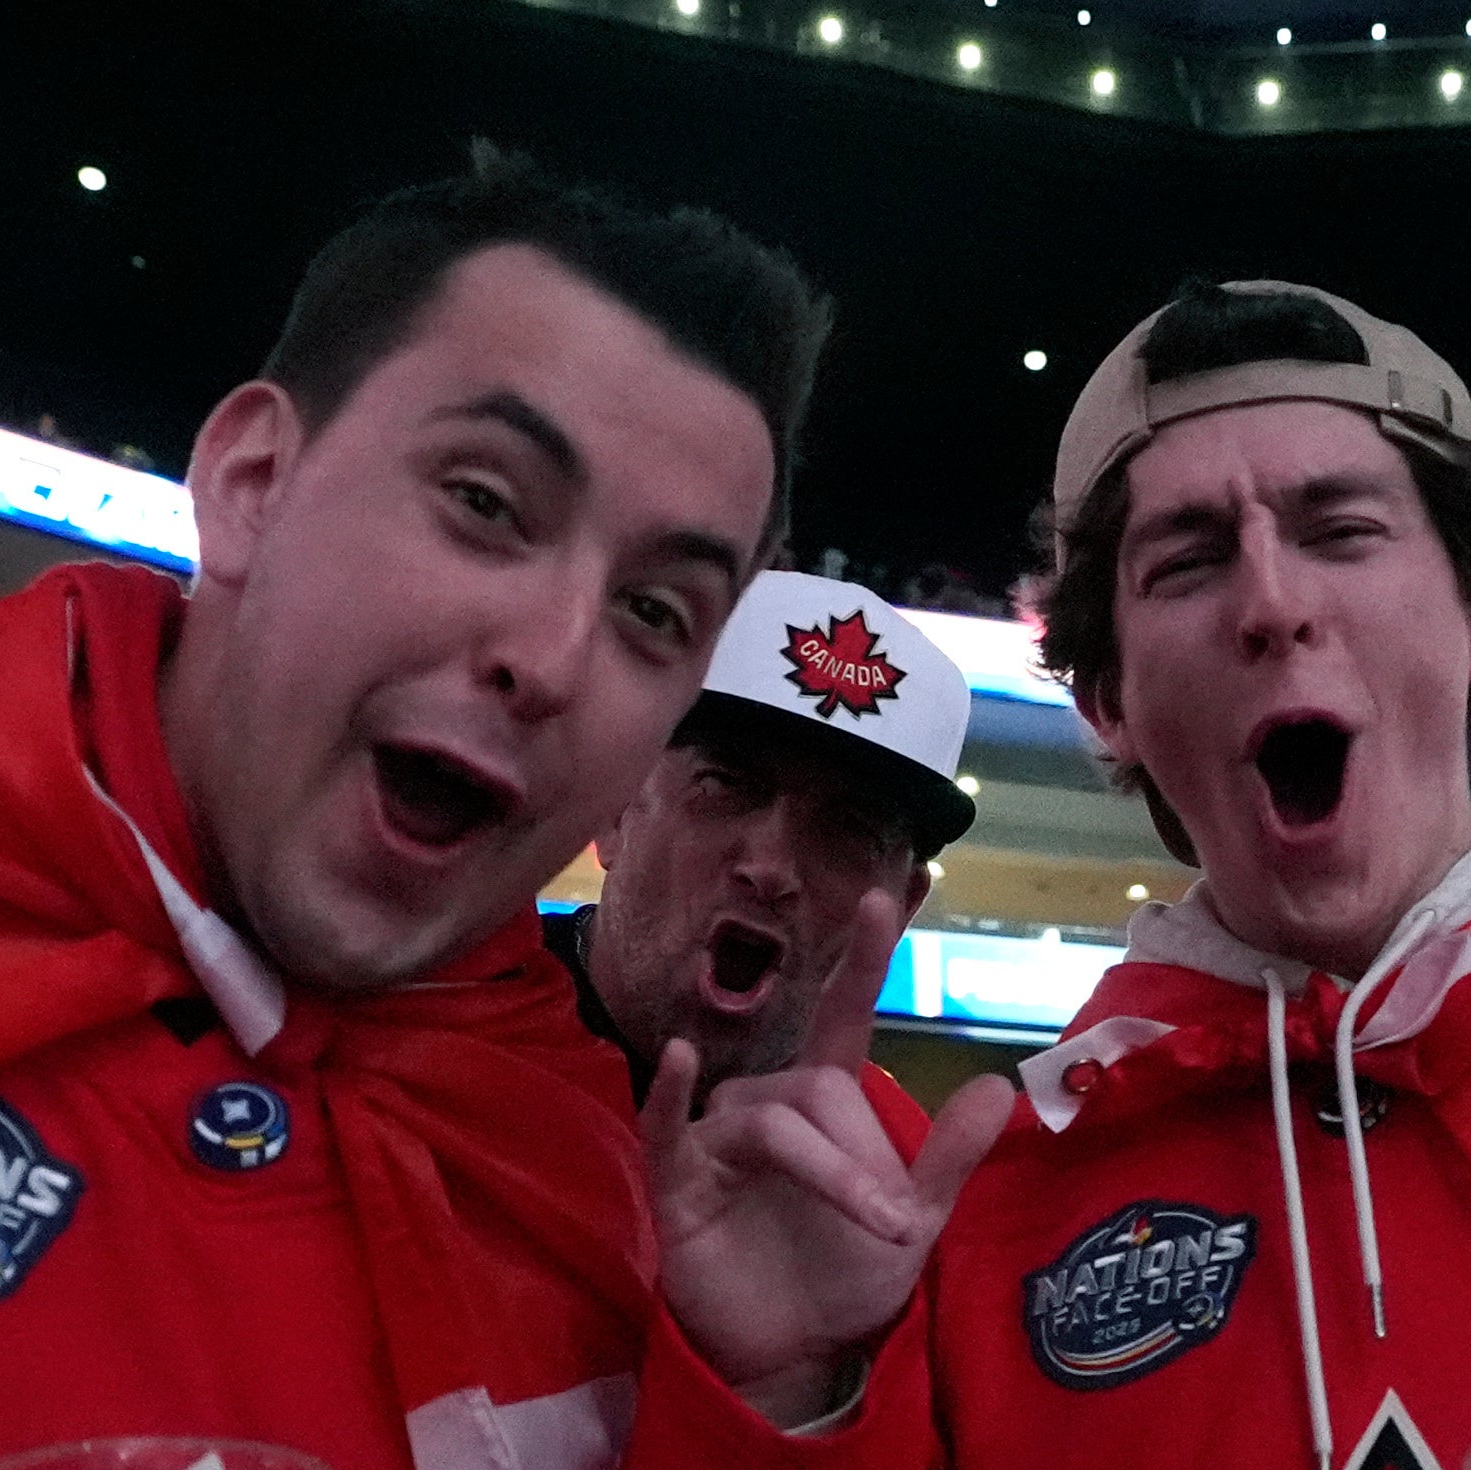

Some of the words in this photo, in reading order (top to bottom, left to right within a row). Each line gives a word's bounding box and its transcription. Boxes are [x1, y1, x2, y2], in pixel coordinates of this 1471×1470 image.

[797, 638, 887, 689] CANADA
[1034, 1222, 1247, 1317] NATIONS
[1052, 1264, 1222, 1337] FACE-OFF
